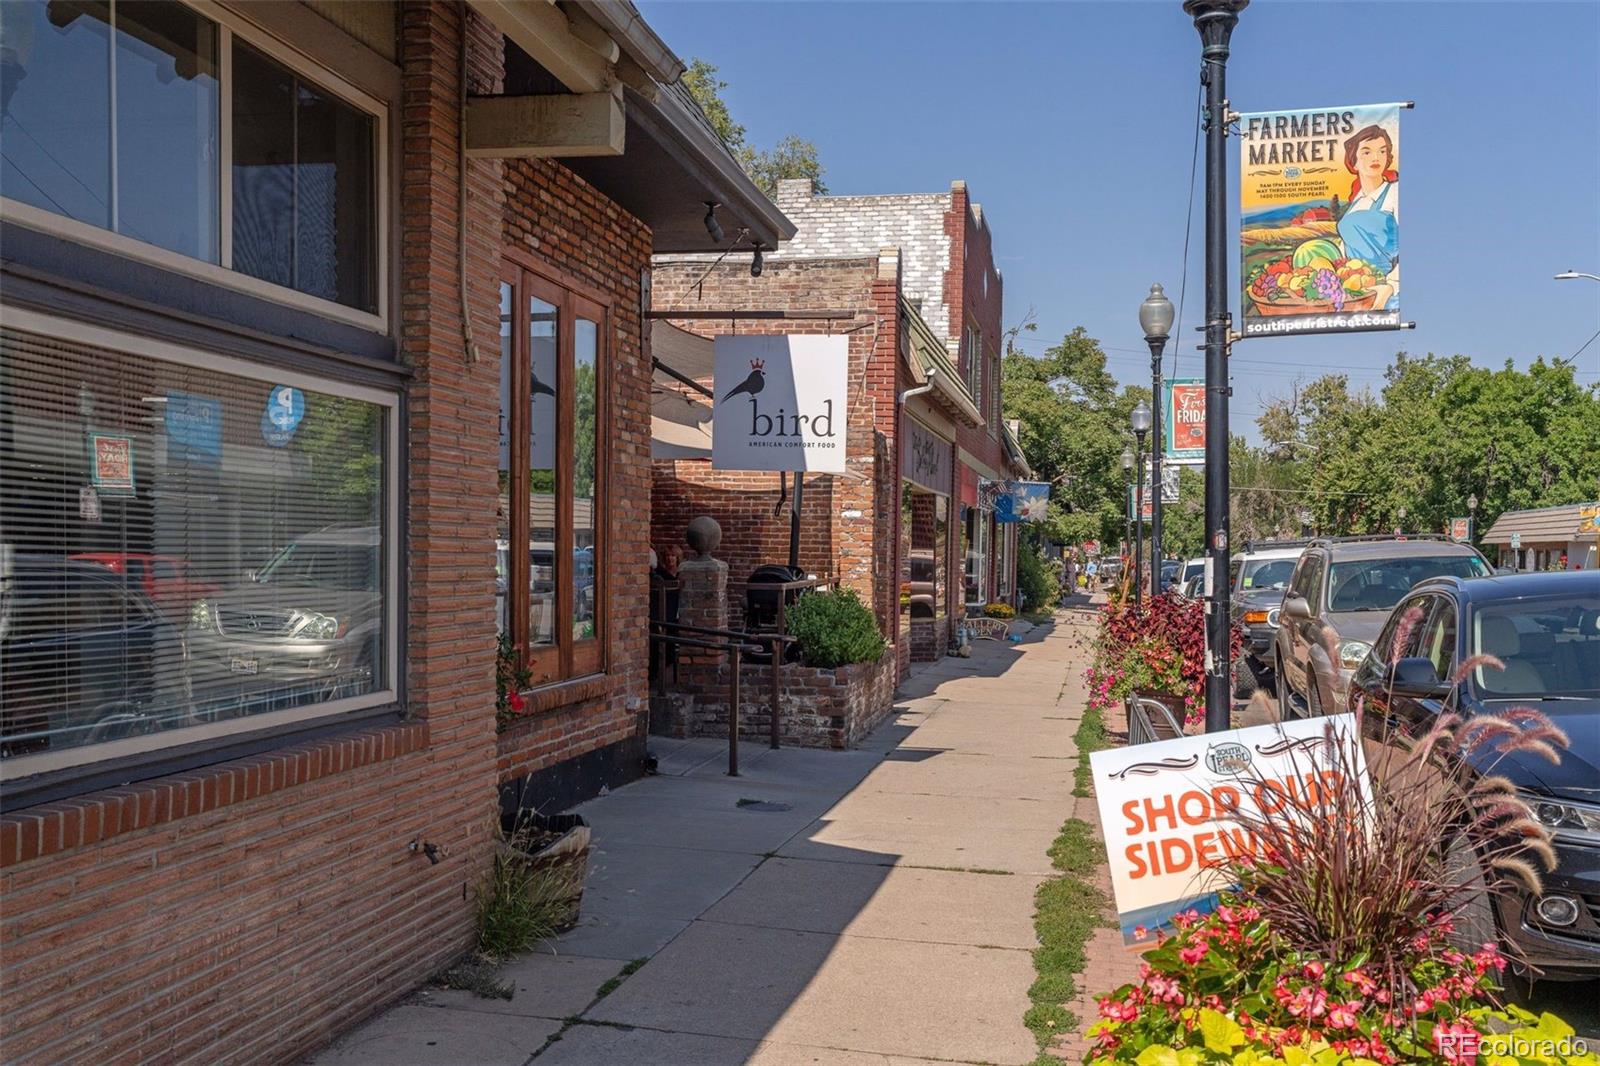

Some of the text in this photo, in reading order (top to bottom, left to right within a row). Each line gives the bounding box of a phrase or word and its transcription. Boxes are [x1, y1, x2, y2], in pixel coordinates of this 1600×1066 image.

[1249, 111, 1354, 140] FARMERS
[1249, 139, 1338, 165] MARKET
[1247, 314, 1398, 333] southpearlstreet.com
[1180, 392, 1206, 410] Firs
[749, 398, 836, 437] bird
[1177, 409, 1206, 423] FRIDA
[1216, 747, 1241, 756] SOUTH
[1122, 786, 1240, 836] SHOP
